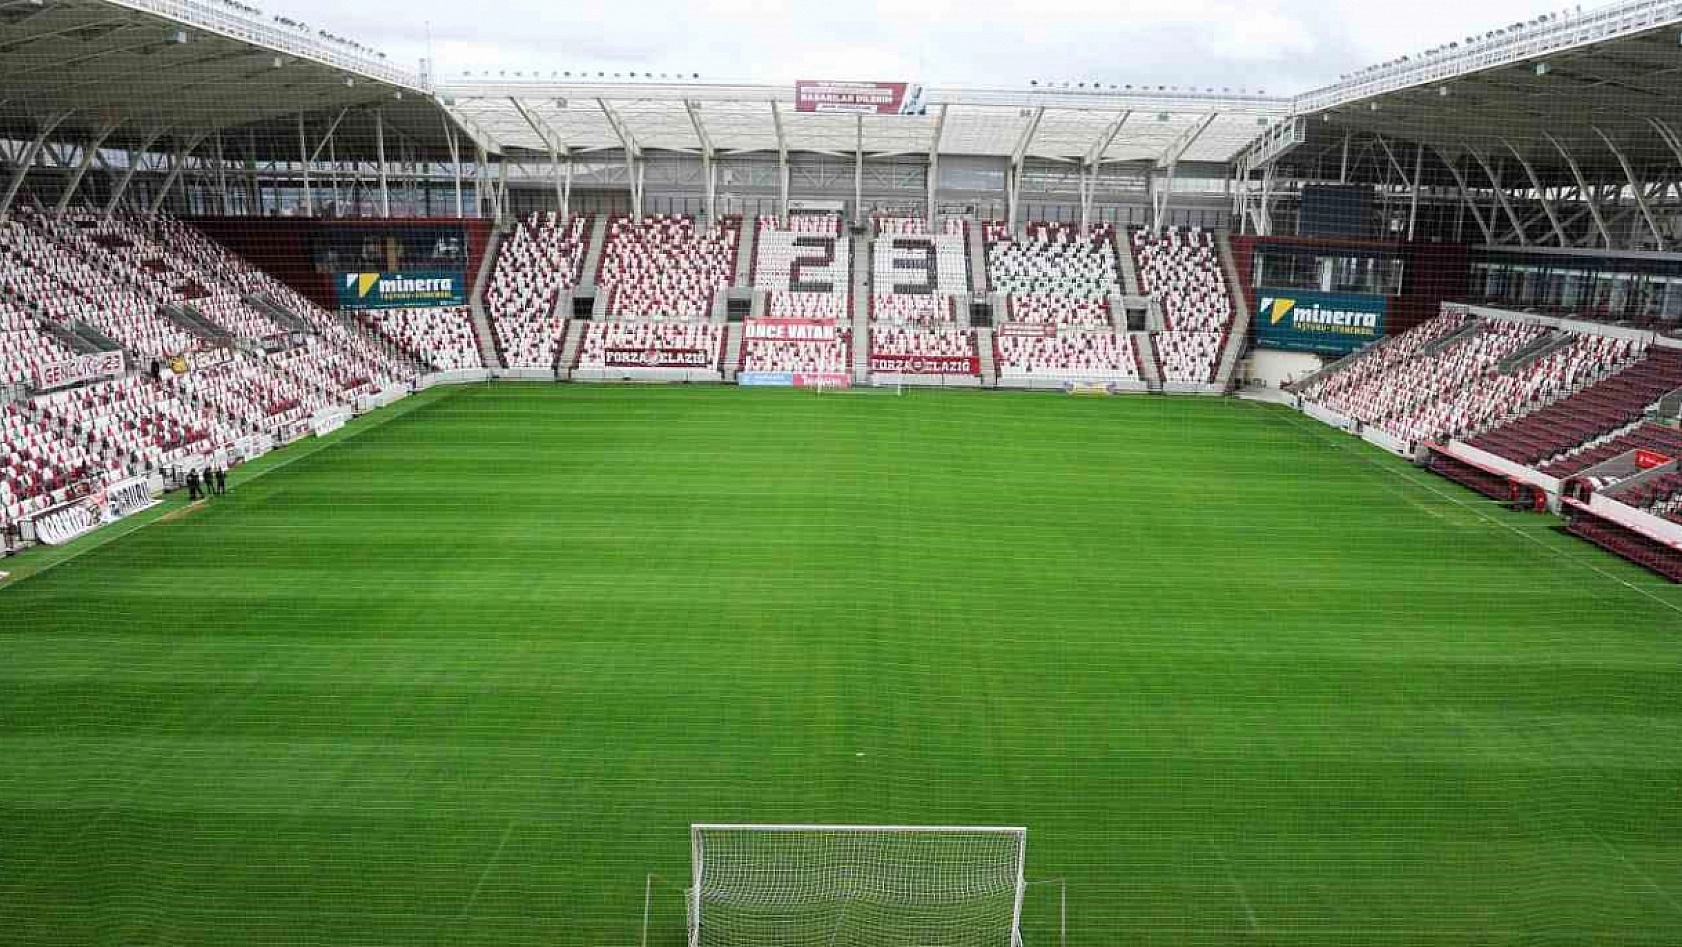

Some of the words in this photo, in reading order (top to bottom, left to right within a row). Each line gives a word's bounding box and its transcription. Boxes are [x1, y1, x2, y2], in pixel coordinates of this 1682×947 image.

[379, 275, 452, 292] minerra
[1294, 304, 1376, 327] minerra
[607, 351, 646, 363] FORZA
[872, 358, 911, 370] FORZA
